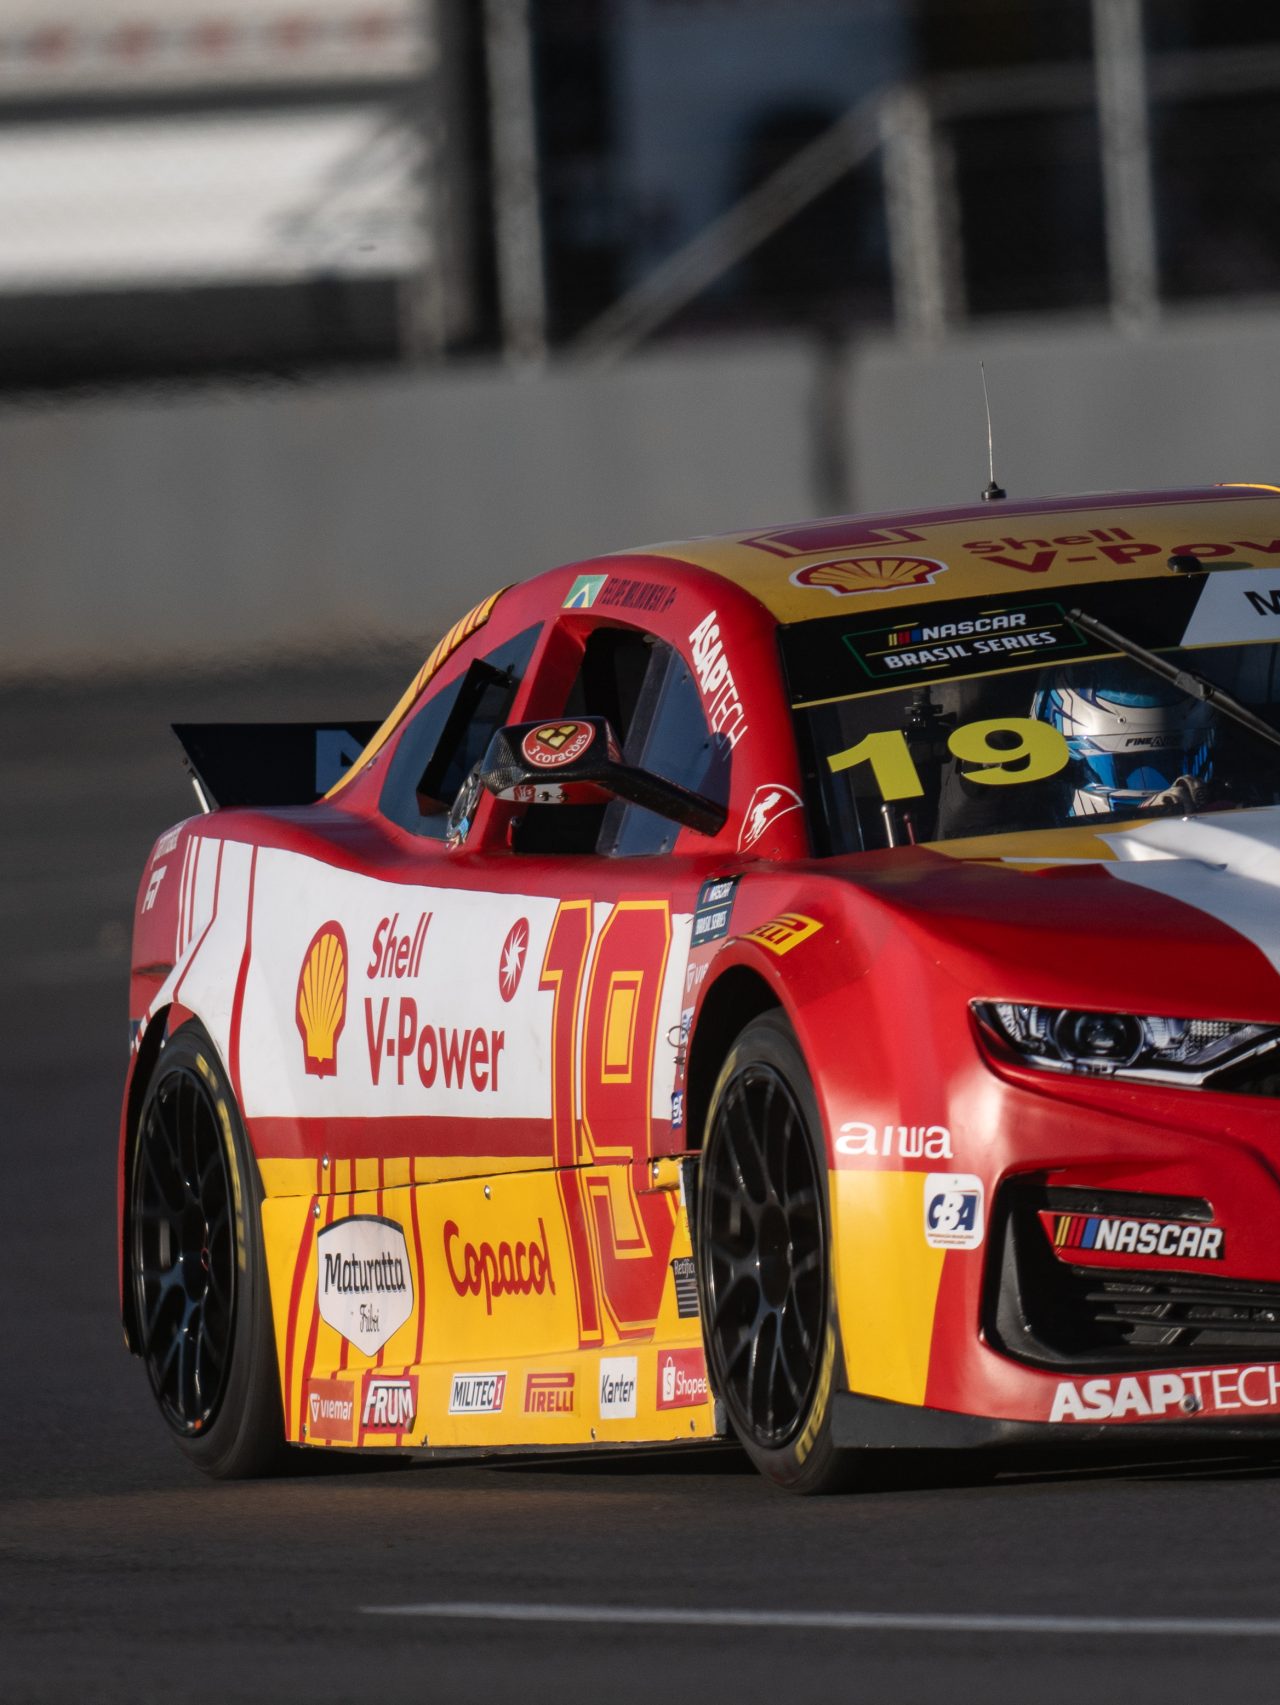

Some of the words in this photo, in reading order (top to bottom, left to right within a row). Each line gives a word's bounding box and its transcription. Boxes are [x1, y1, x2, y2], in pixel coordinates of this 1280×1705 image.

[963, 527, 1127, 556] Shell
[921, 613, 1027, 641] NASCAR
[883, 645, 972, 669] BRASIL
[973, 631, 1057, 654] SERIES
[689, 610, 748, 761] ASAPTECH
[528, 746, 540, 755] 3
[827, 718, 1070, 801] 19
[365, 912, 433, 979] Shell
[364, 996, 505, 1092] V-Power
[538, 898, 674, 1348] 19
[836, 1121, 953, 1159] aiwa
[1095, 1219, 1224, 1260] NASCAR
[323, 1252, 407, 1294] Maturatta
[443, 1217, 556, 1316] Copacol
[362, 1379, 414, 1427] FRUM
[524, 1373, 575, 1412] PIRELLI
[601, 1375, 634, 1404] Karter
[676, 1371, 707, 1401] Shopee
